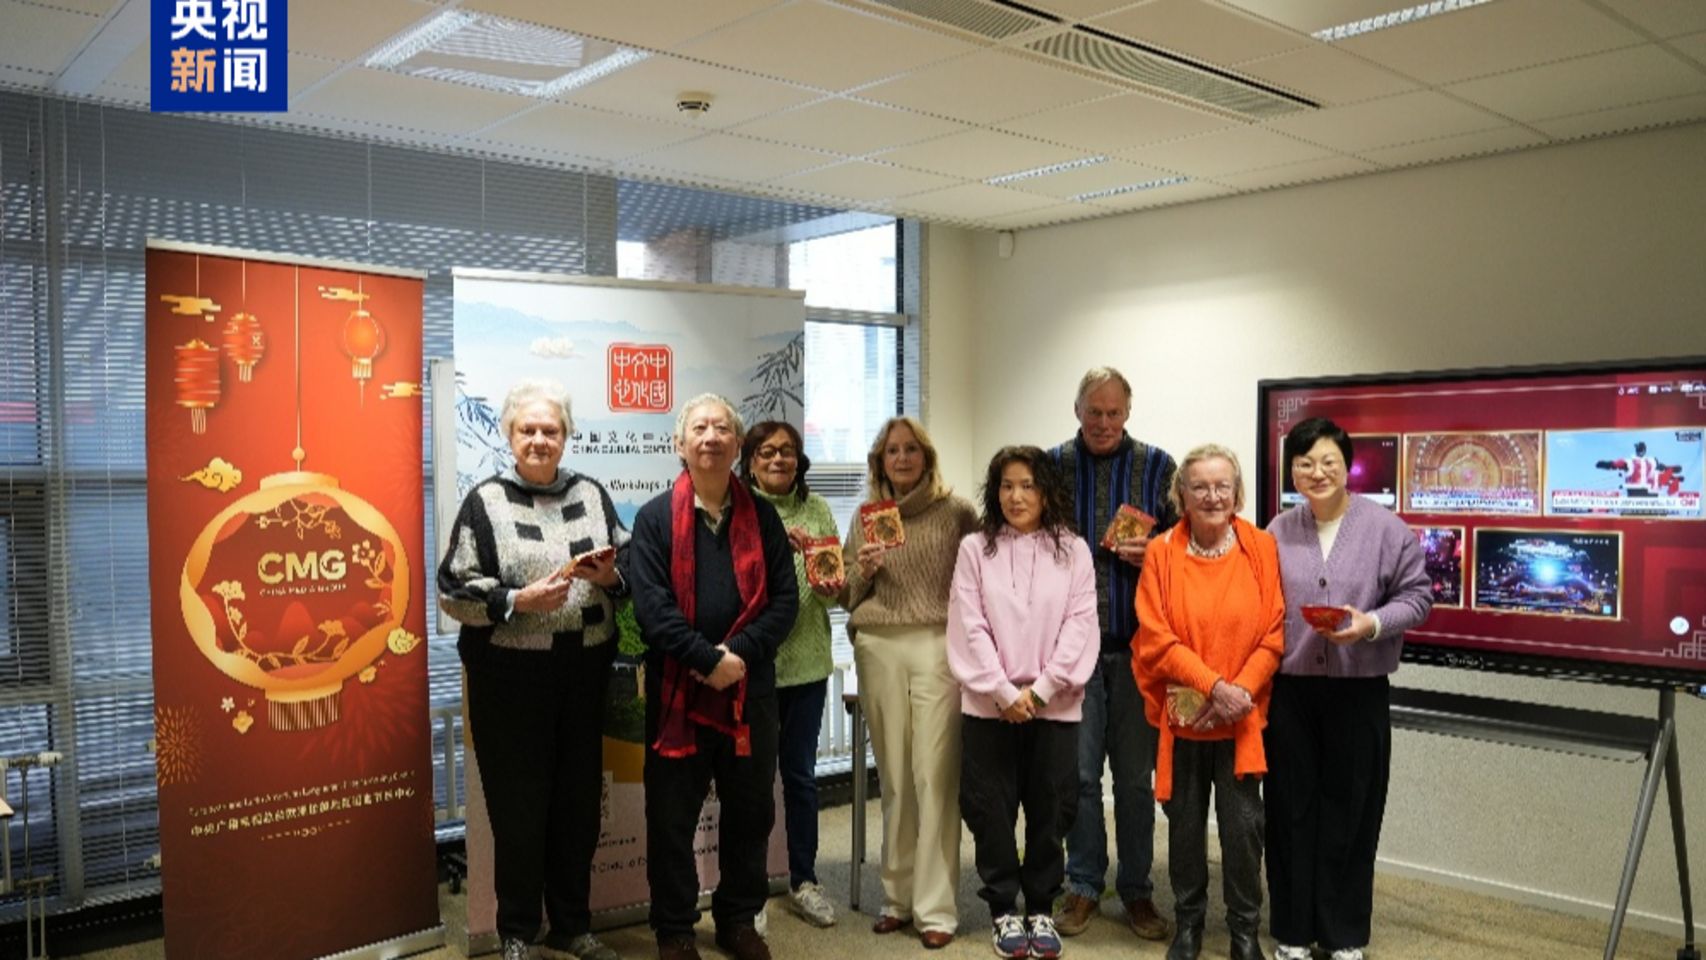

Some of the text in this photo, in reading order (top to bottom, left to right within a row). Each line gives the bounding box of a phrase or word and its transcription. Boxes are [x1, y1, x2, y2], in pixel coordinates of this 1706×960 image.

[572, 444, 600, 454] CHINA
[610, 479, 660, 493] Workshops
[257, 549, 347, 585] CMG
